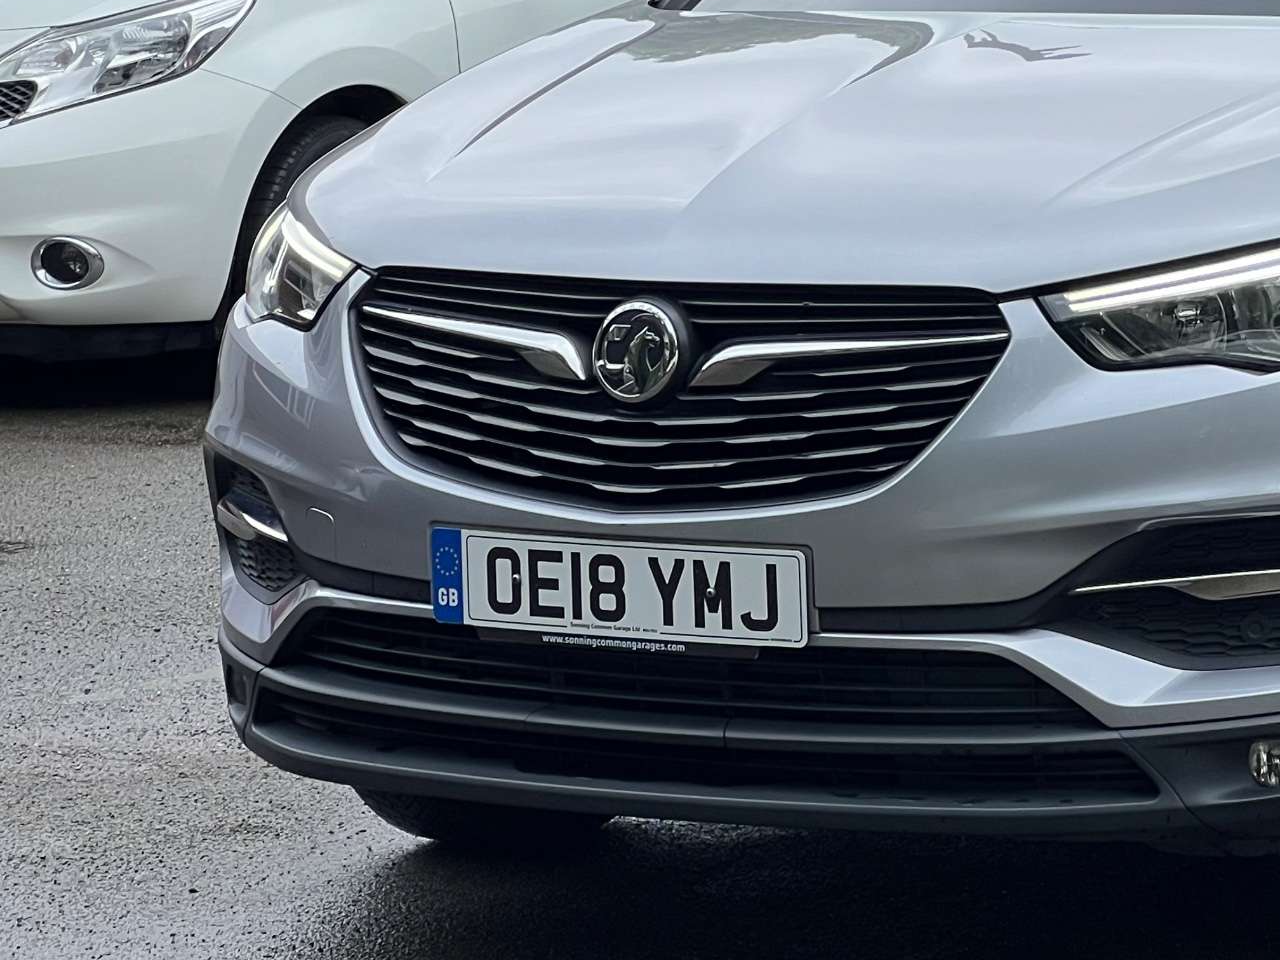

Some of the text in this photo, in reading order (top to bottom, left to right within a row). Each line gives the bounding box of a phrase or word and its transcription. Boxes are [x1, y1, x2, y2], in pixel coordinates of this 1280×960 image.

[438, 586, 459, 607] GB
[486, 546, 779, 633] OE18 YMJ
[541, 633, 686, 652] www.sonningcommongarages.com
